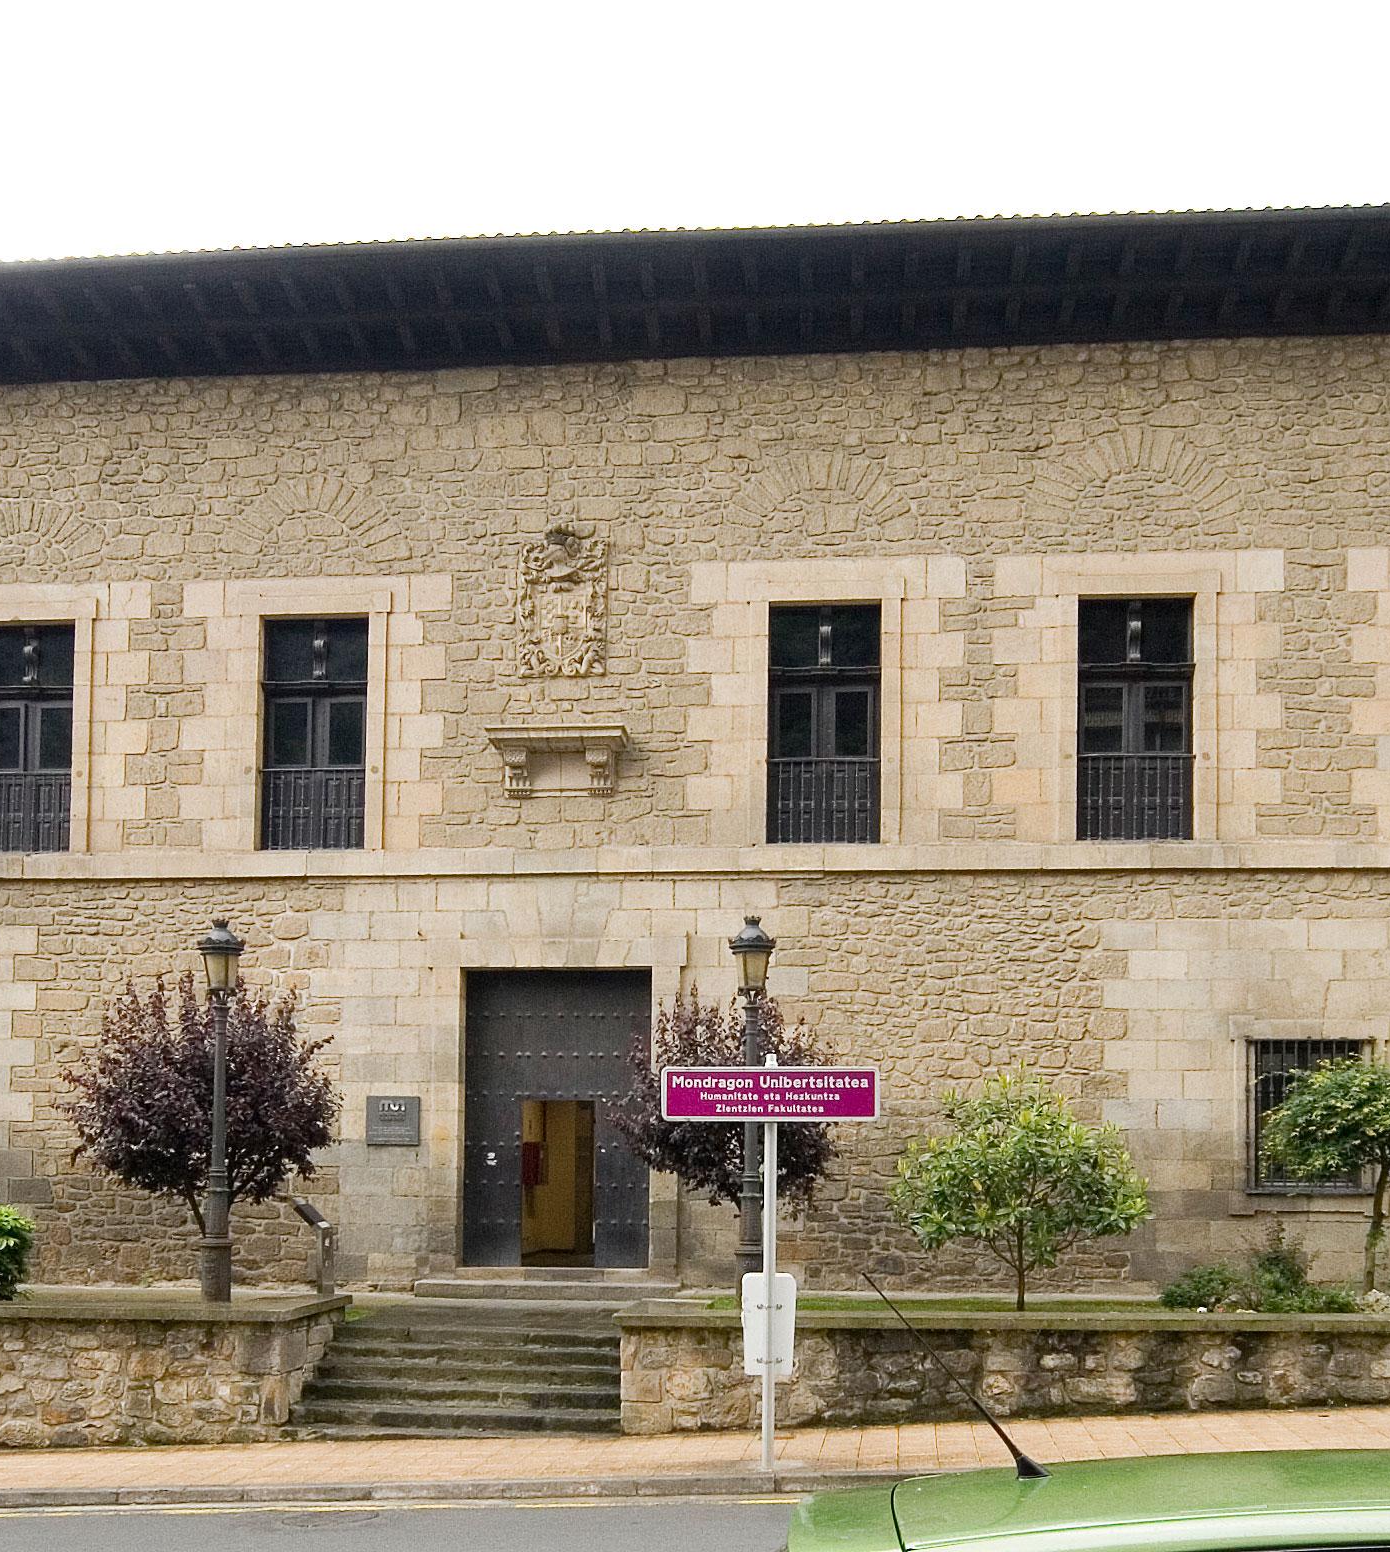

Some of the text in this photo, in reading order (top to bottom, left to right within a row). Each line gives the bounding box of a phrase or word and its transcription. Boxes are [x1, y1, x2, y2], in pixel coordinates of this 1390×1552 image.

[672, 1075, 869, 1089] Mondragon Unibertsitatea
[700, 1091, 840, 1101] Humanitate eta Hezkuntza
[715, 1103, 824, 1113] Zientzien Fakultatea
